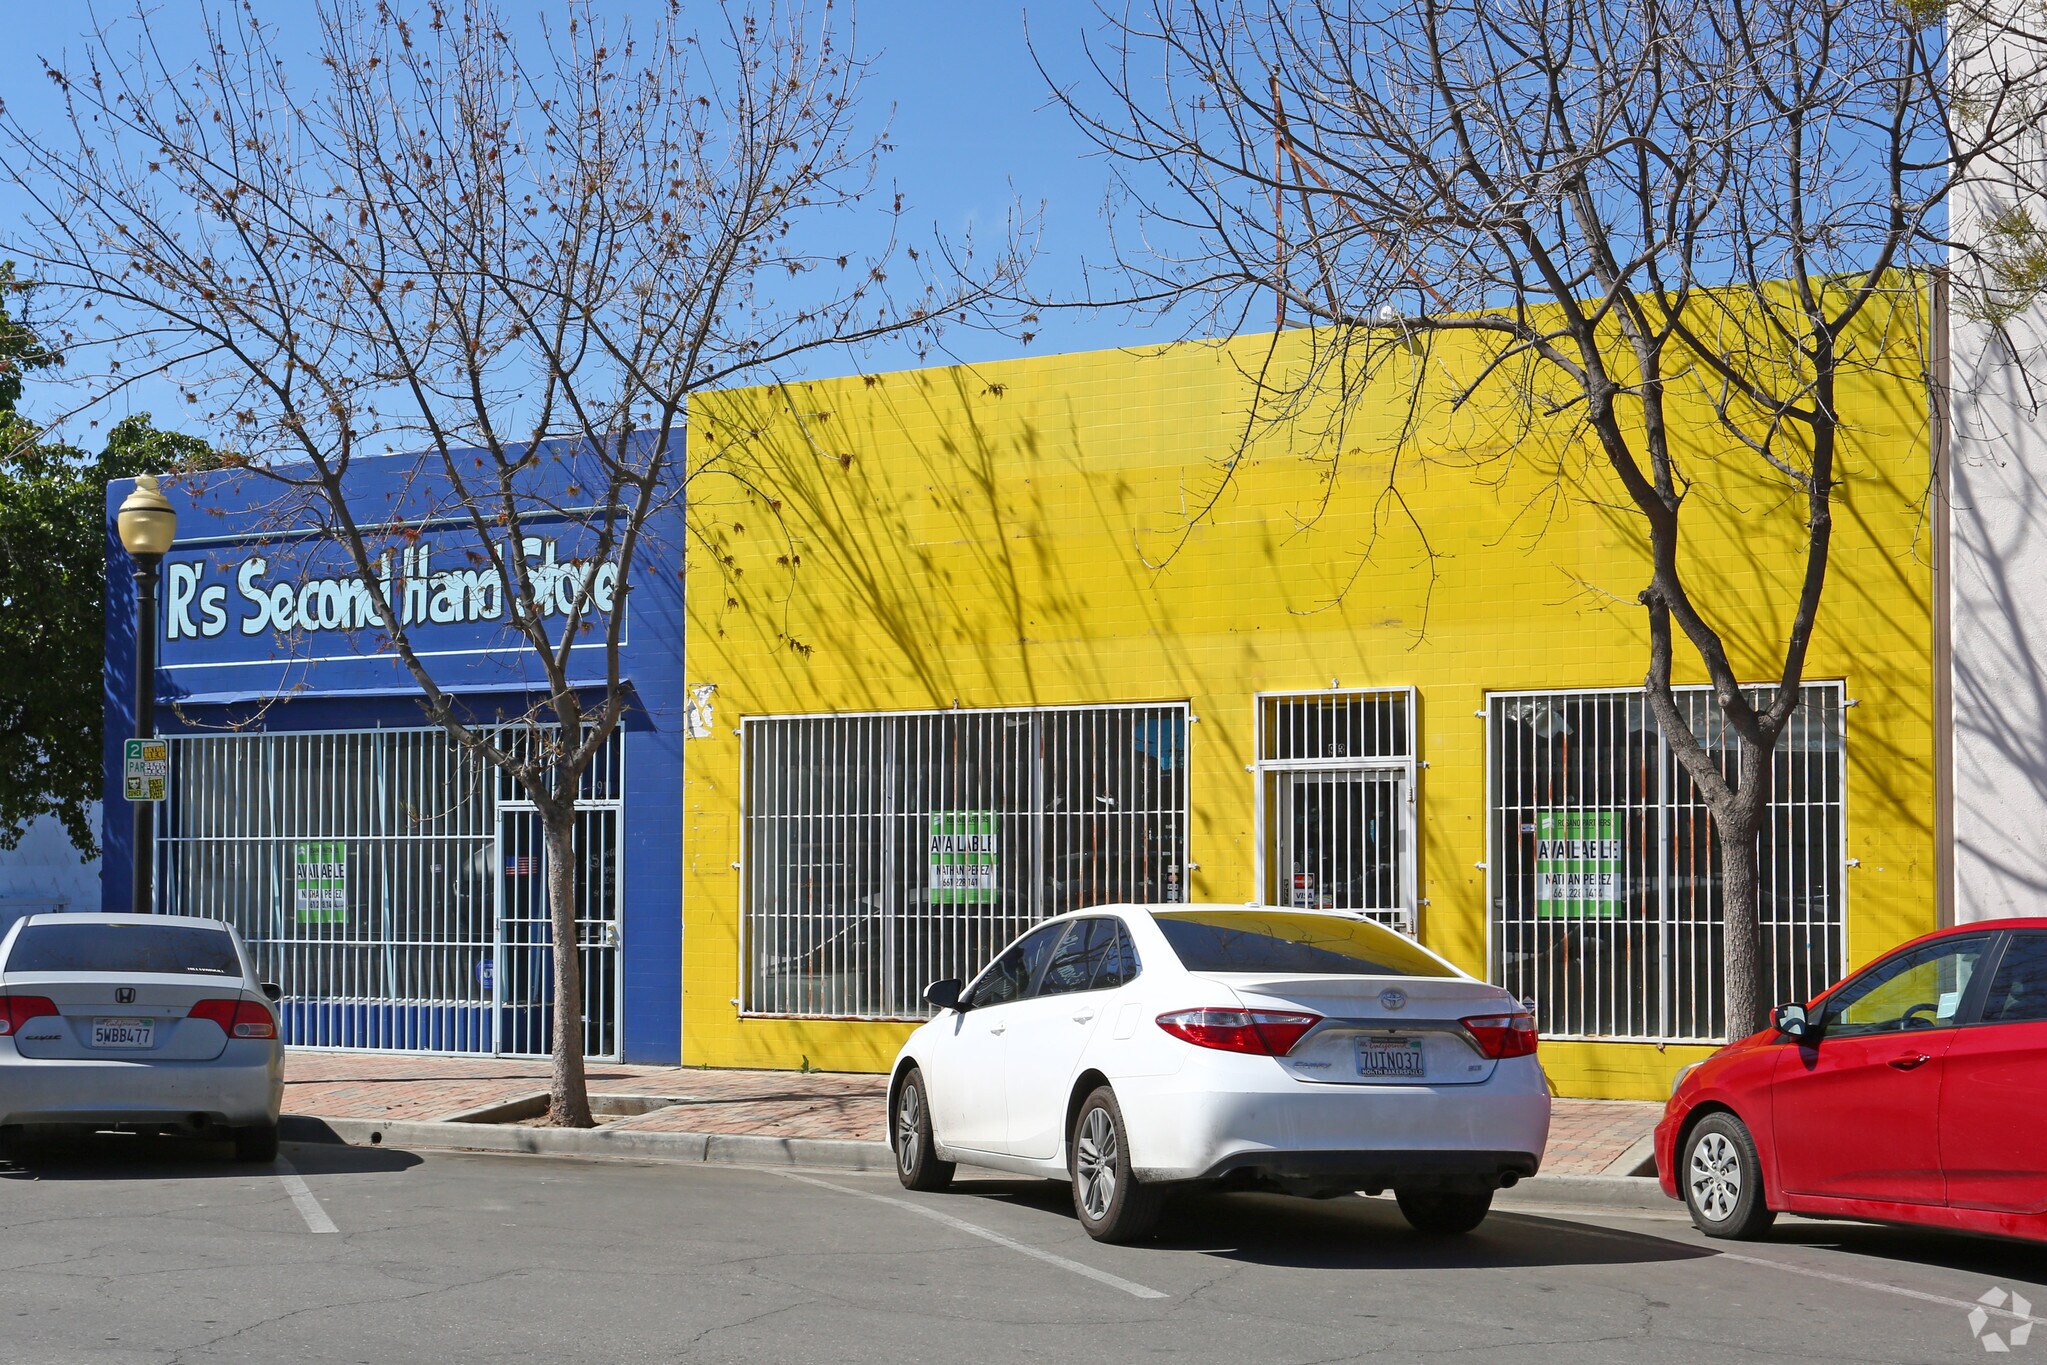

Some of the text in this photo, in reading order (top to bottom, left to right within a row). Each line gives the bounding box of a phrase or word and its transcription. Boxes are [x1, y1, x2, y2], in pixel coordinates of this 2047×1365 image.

[168, 537, 620, 639] R's Second Hand Store
[130, 743, 140, 757] 2
[931, 836, 993, 852] AVALABLE
[1538, 841, 1618, 859] AVAILABLE
[298, 864, 344, 879] AVAILABLE
[302, 889, 342, 899] NTHA PEEZ
[96, 1028, 150, 1043] 5WBB477
[1361, 1051, 1420, 1069] 7UIN037
